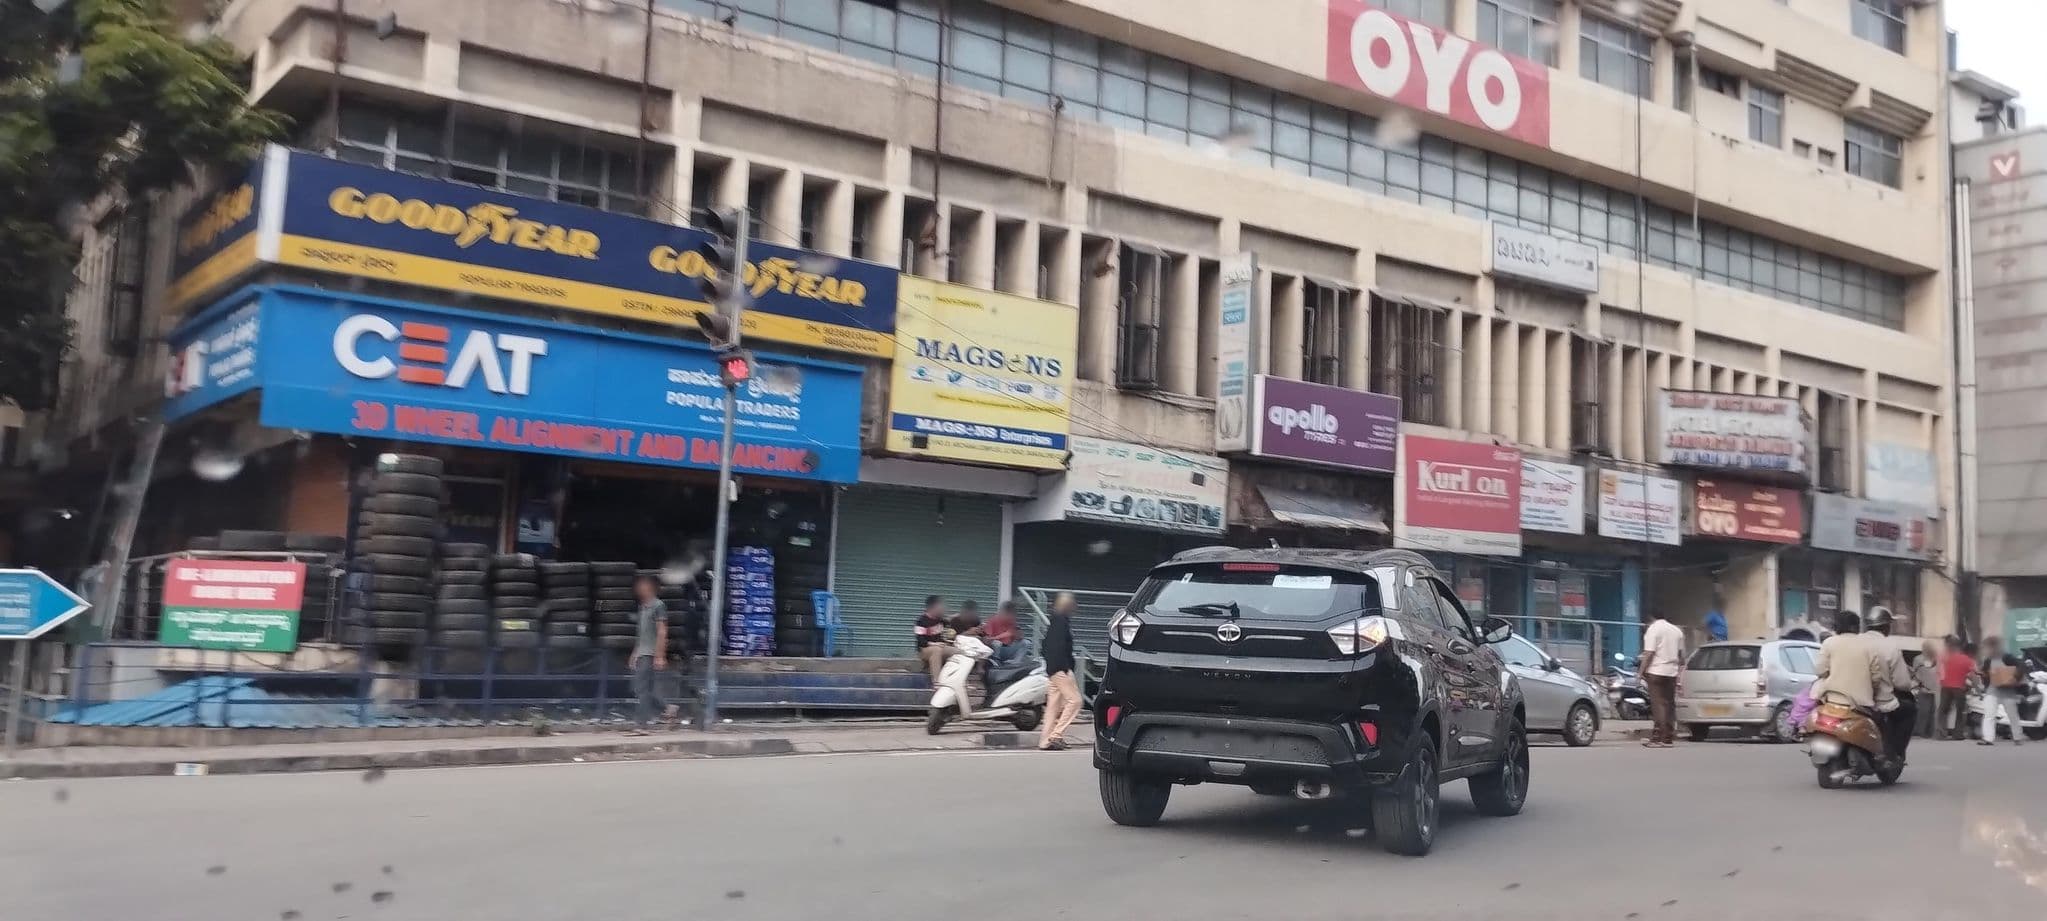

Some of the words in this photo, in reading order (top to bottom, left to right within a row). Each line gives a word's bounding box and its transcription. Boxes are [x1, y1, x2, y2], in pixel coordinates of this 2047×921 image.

[1351, 9, 1522, 132] OYO
[328, 186, 601, 260] GOODYEAR
[333, 313, 549, 396] CEAT
[351, 400, 387, 431] 3D
[394, 404, 484, 442] WHEEL
[637, 432, 686, 462] AND
[665, 390, 726, 411] POPULA
[735, 400, 801, 421] TRADERS
[1268, 403, 1340, 435] apollo
